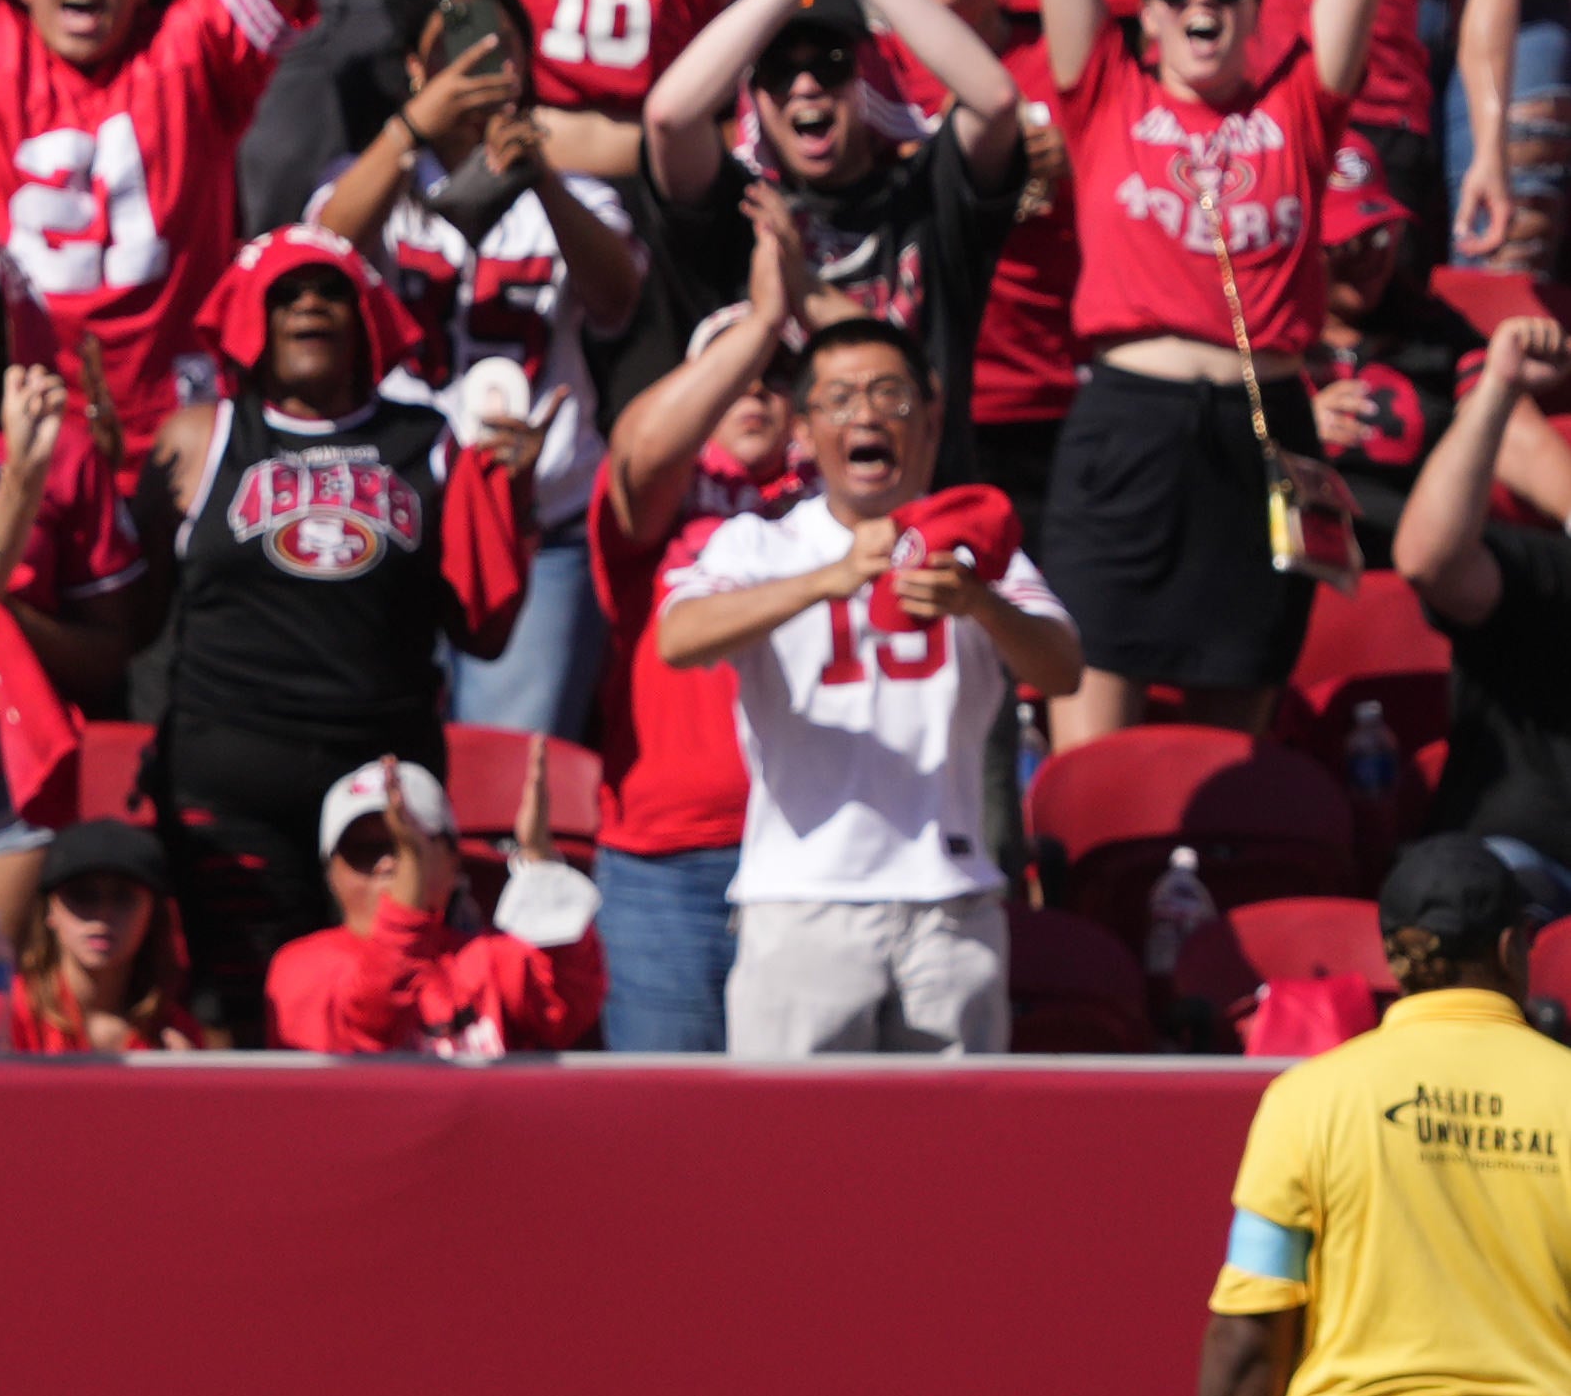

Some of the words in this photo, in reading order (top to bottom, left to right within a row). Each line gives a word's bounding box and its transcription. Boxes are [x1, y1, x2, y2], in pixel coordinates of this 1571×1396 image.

[4, 111, 172, 302] 21
[1416, 1082, 1504, 1118] ALLIED
[1416, 1114, 1558, 1156] UNIVERSAL
